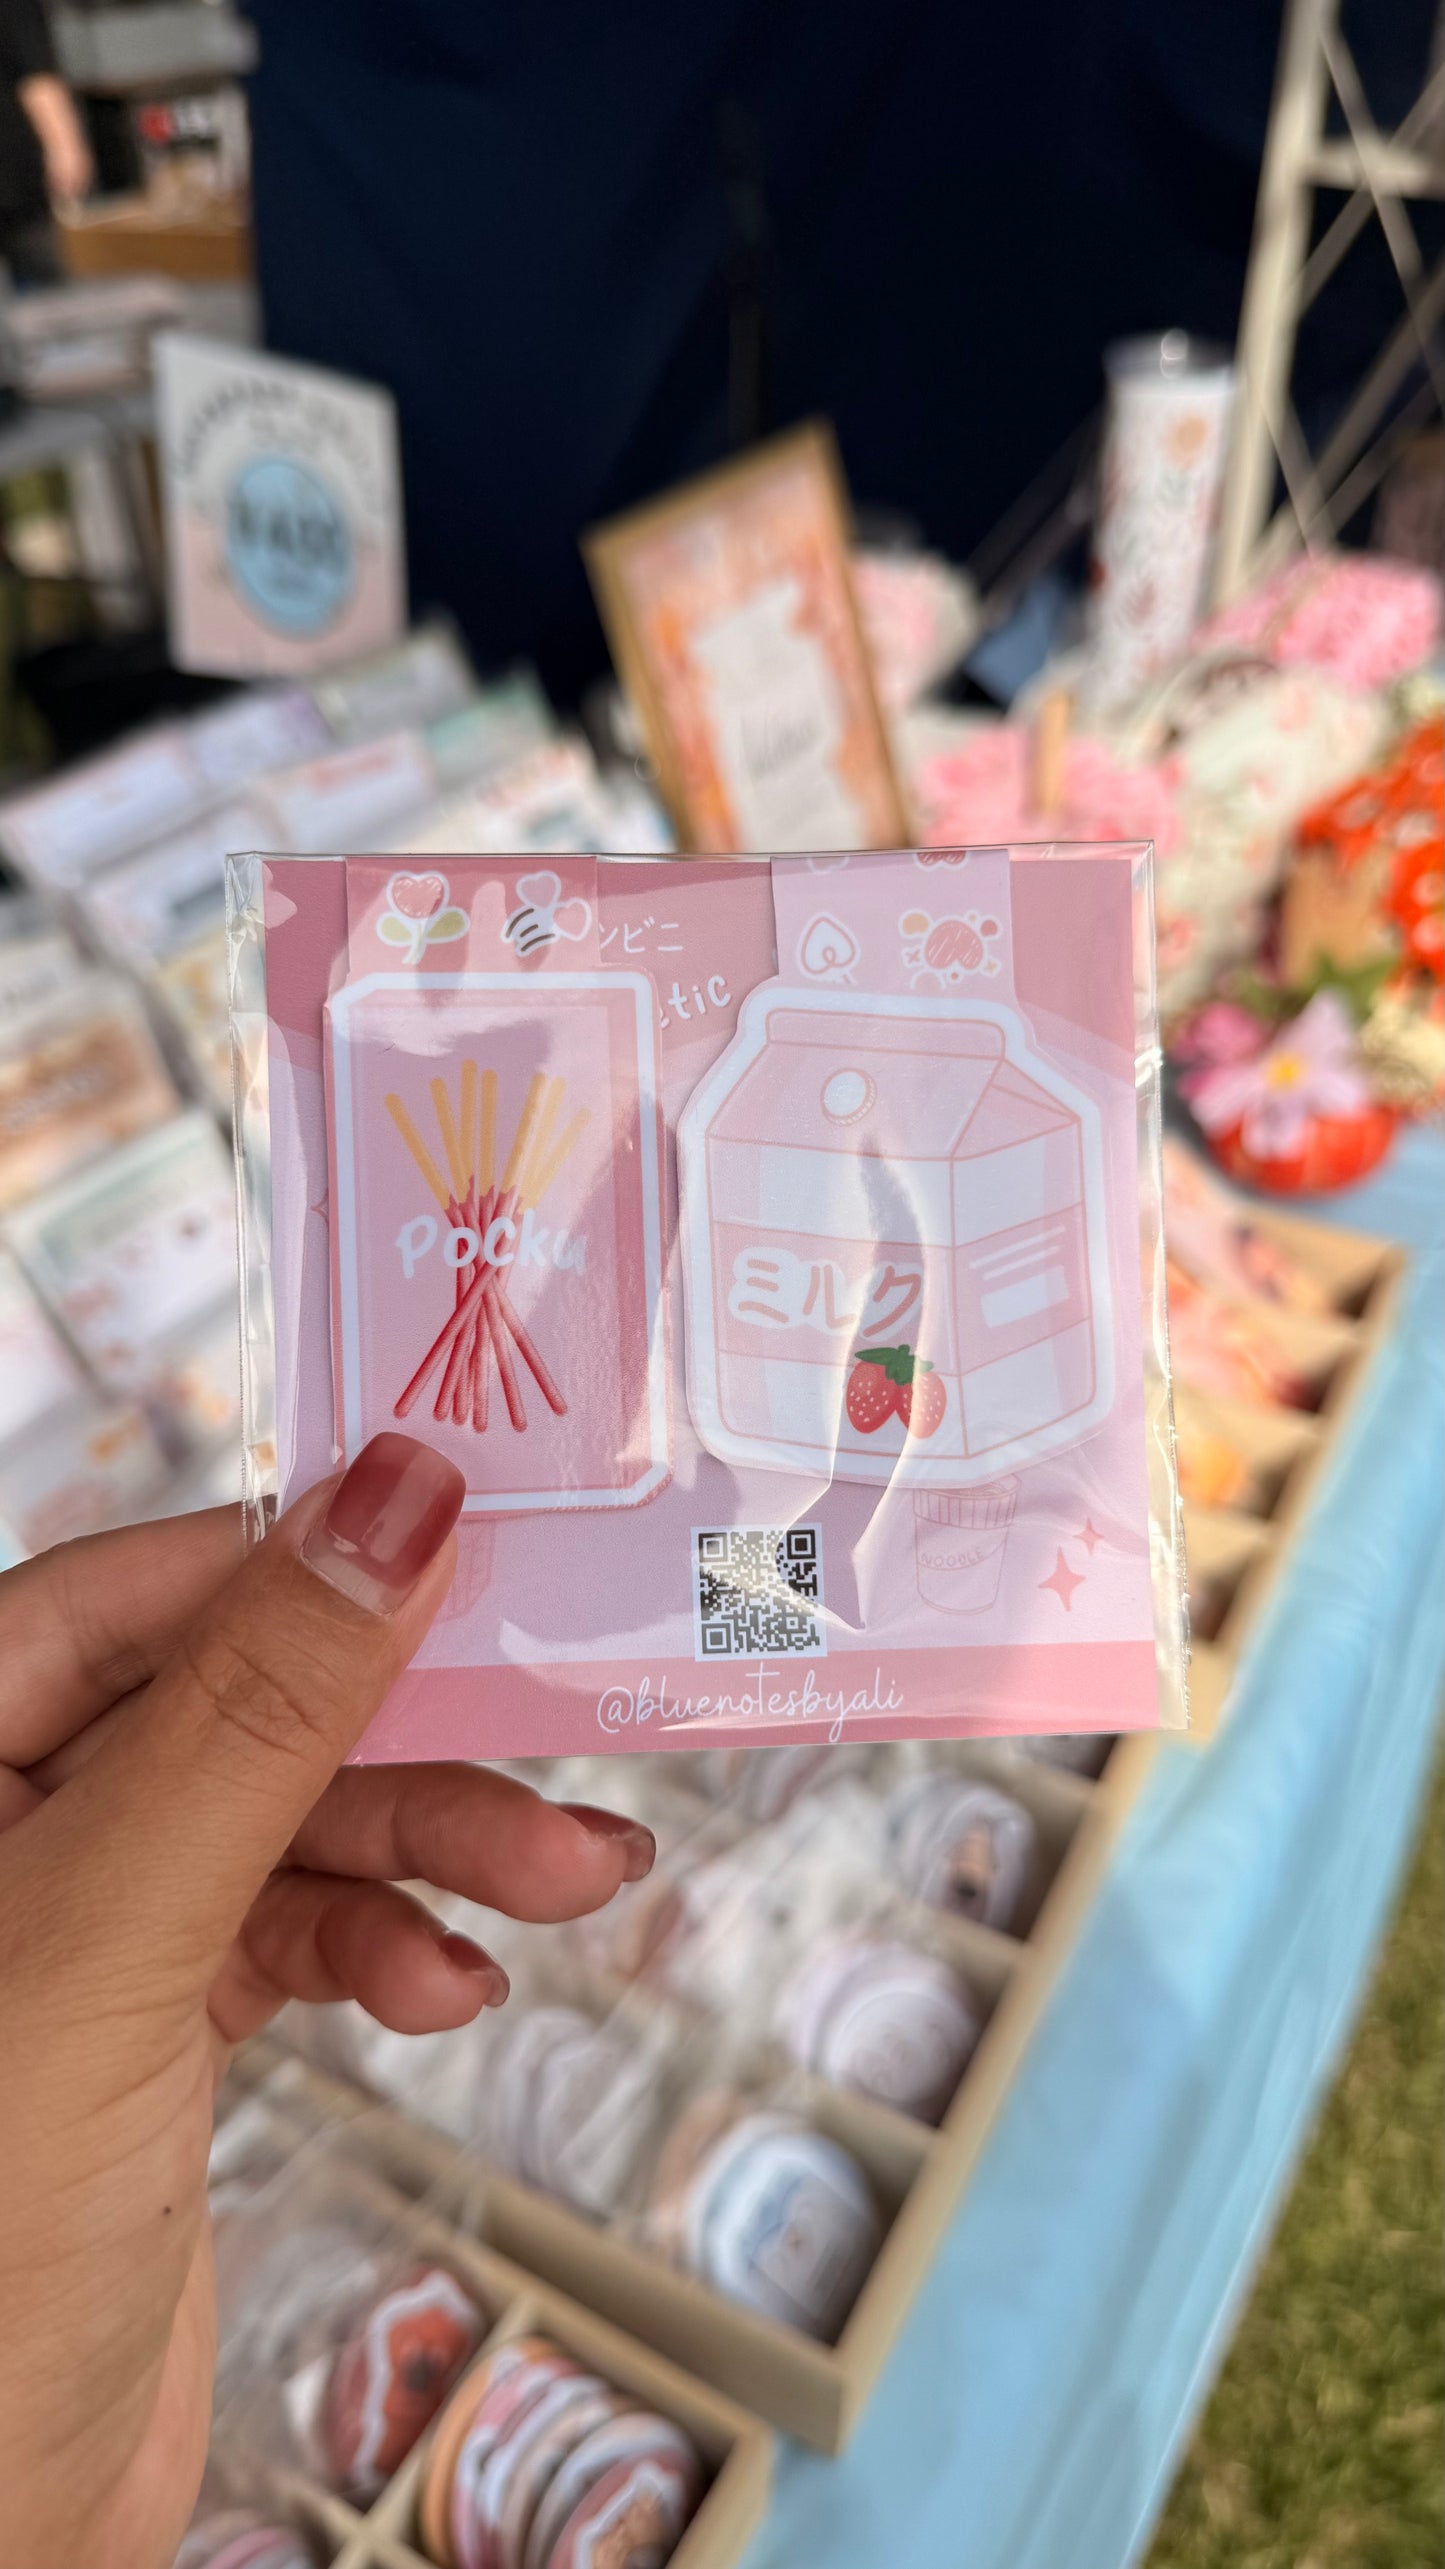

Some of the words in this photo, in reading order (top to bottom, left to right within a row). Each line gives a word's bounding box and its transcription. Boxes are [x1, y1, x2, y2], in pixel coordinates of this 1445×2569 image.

[660, 975, 732, 1029] tic
[737, 1259, 922, 1338] ミルク
[597, 1661, 904, 1743] @bluenotesbyali
